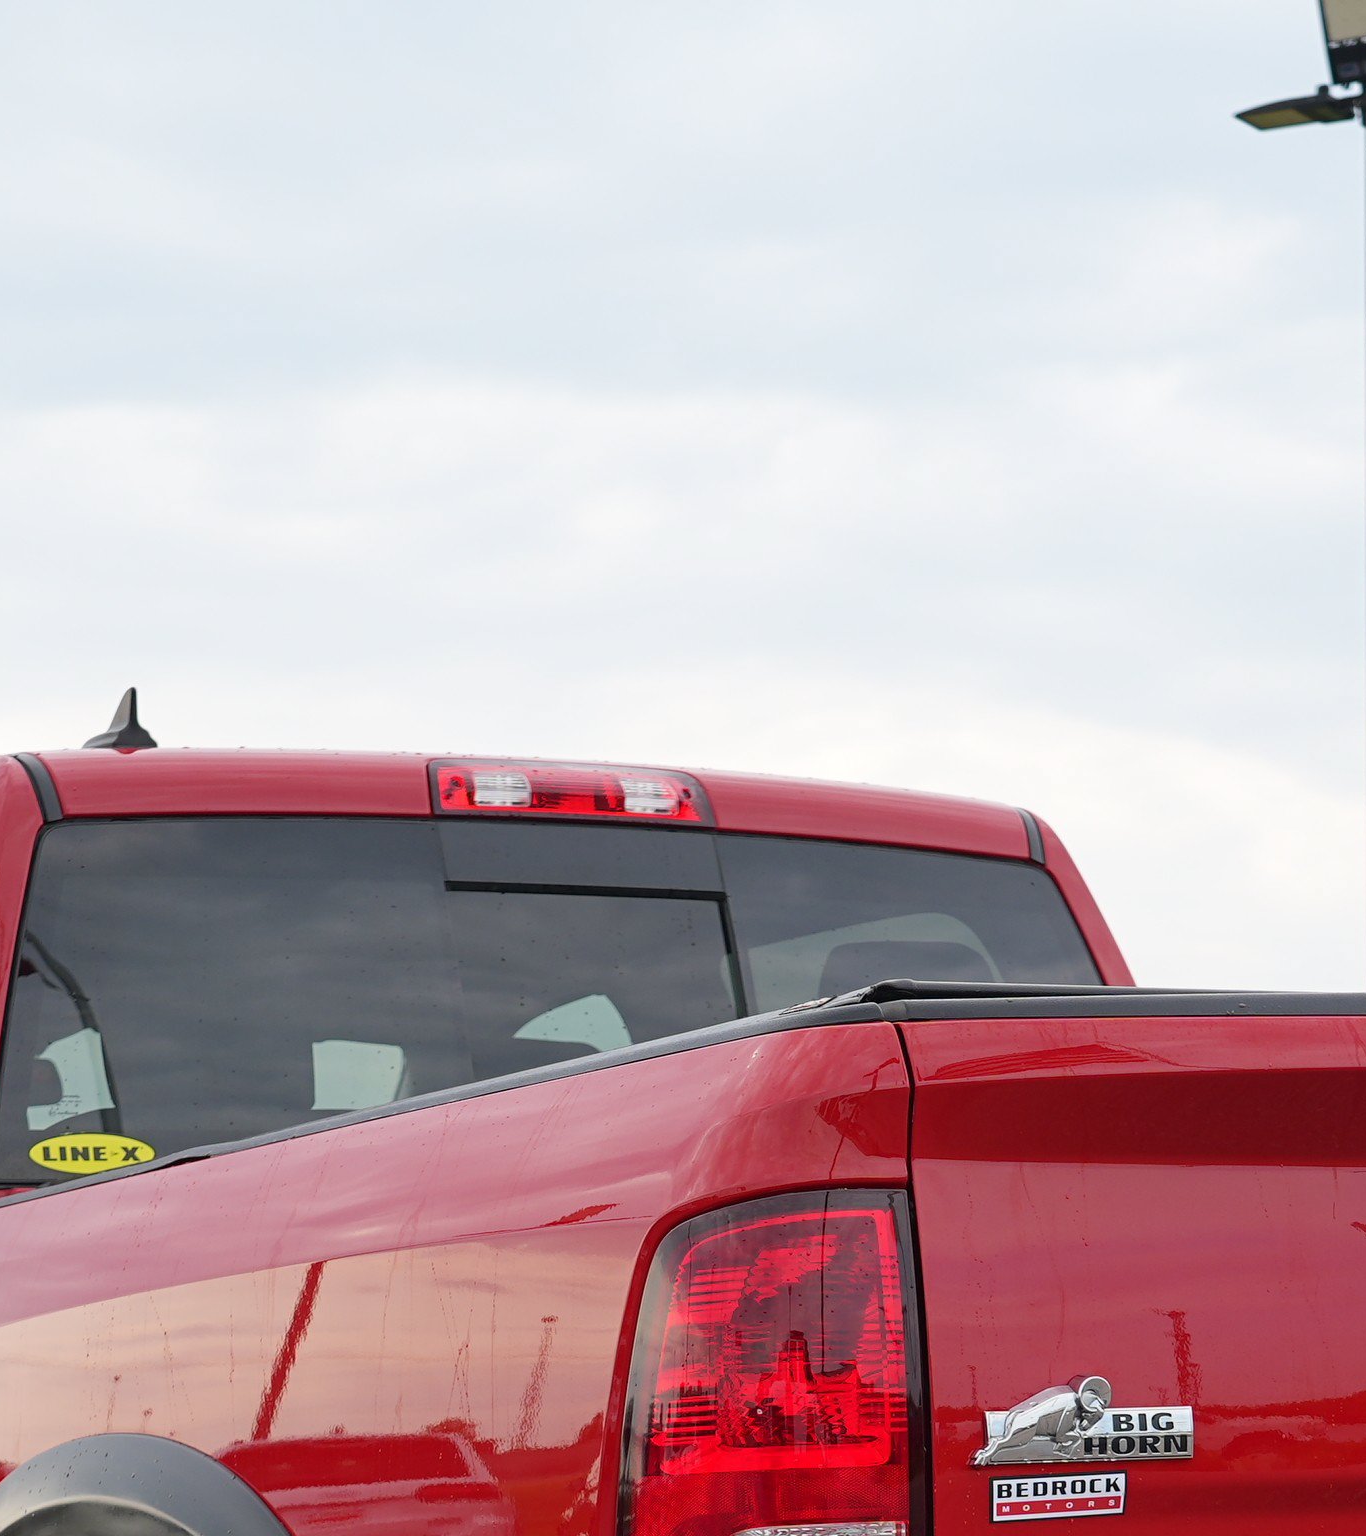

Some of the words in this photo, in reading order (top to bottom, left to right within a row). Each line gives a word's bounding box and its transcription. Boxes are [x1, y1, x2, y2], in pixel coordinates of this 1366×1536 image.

[1111, 1412, 1175, 1433] BIG
[1083, 1434, 1186, 1456] HORN
[996, 1477, 1121, 1499] BEDROCK
[1001, 1498, 1116, 1513] MOTORS
